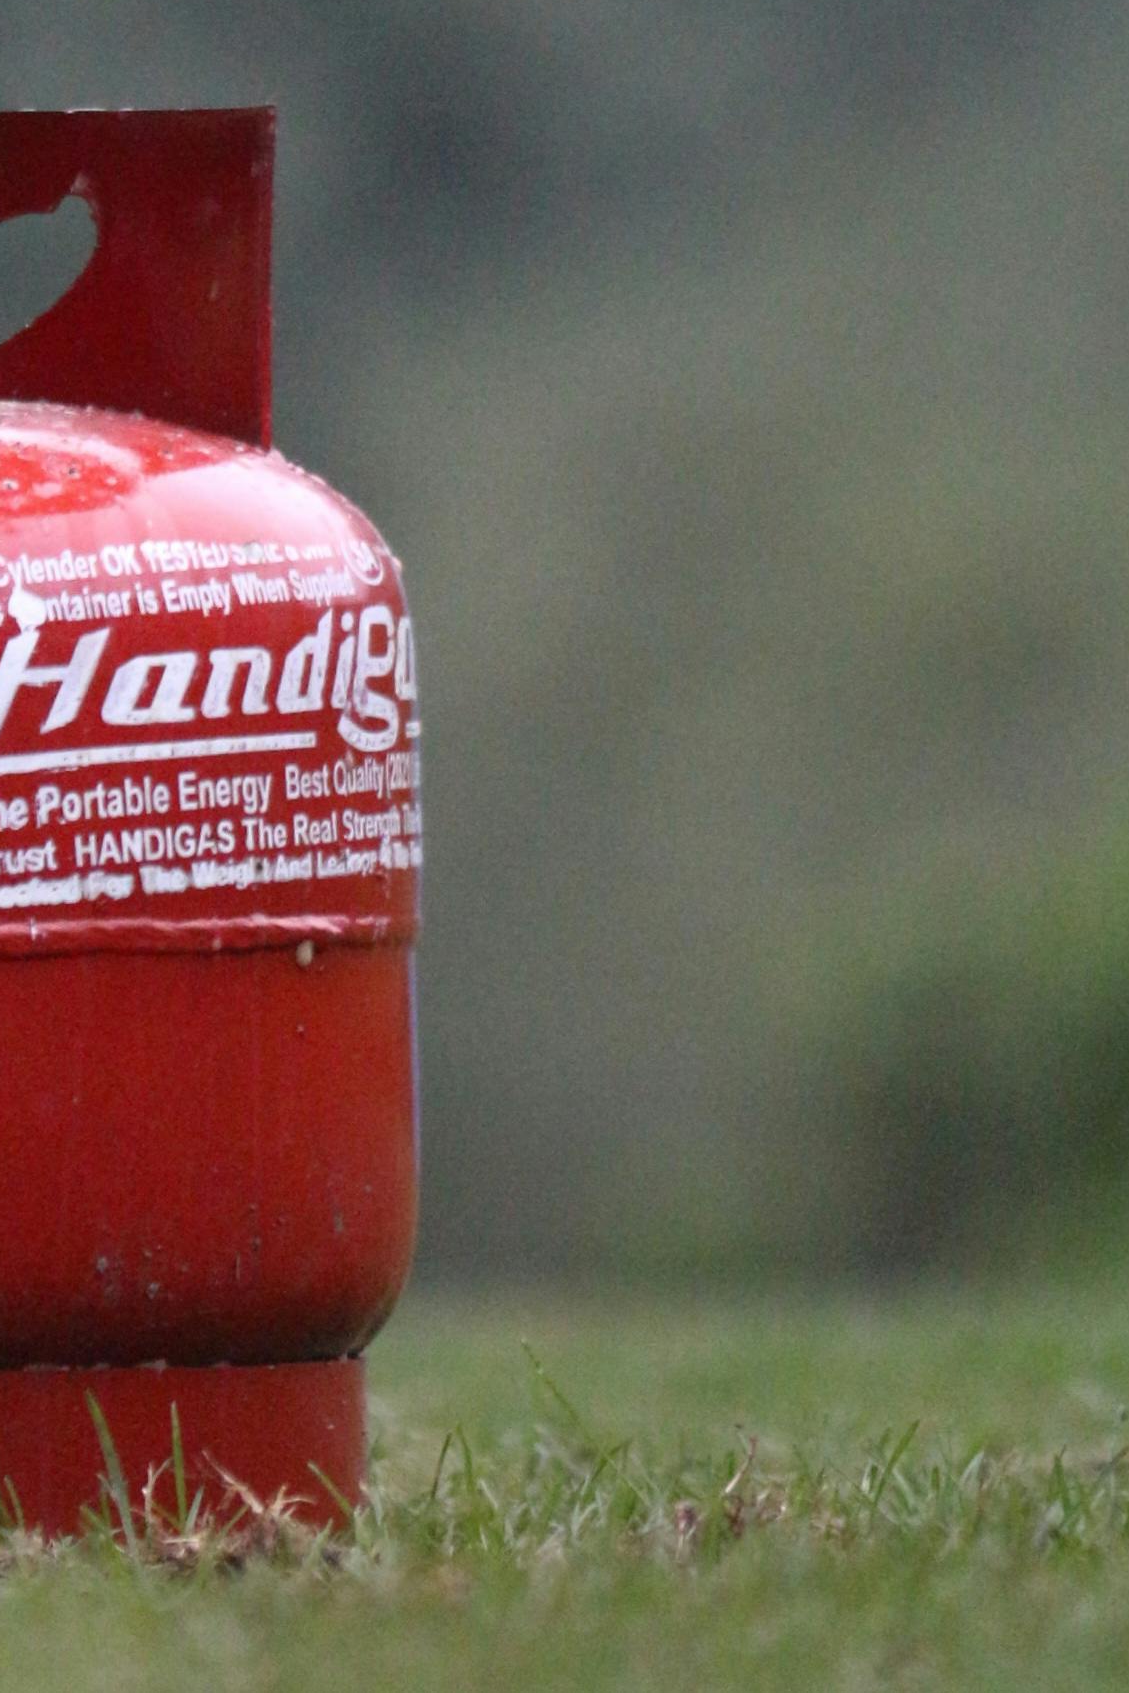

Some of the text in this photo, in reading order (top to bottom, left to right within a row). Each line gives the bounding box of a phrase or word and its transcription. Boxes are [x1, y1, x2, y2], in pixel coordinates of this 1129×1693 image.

[99, 544, 142, 577] OK
[8, 586, 131, 626] ntainer
[134, 581, 159, 615] is
[161, 575, 231, 618] Empty
[231, 570, 290, 606] When
[35, 775, 171, 828] Portable
[177, 771, 272, 814] Energy
[284, 764, 331, 800] Best
[333, 757, 384, 799] Quality
[74, 819, 236, 867] HANDIGAS
[241, 818, 288, 851] The
[293, 810, 338, 846] Real
[342, 805, 402, 841] Strength
